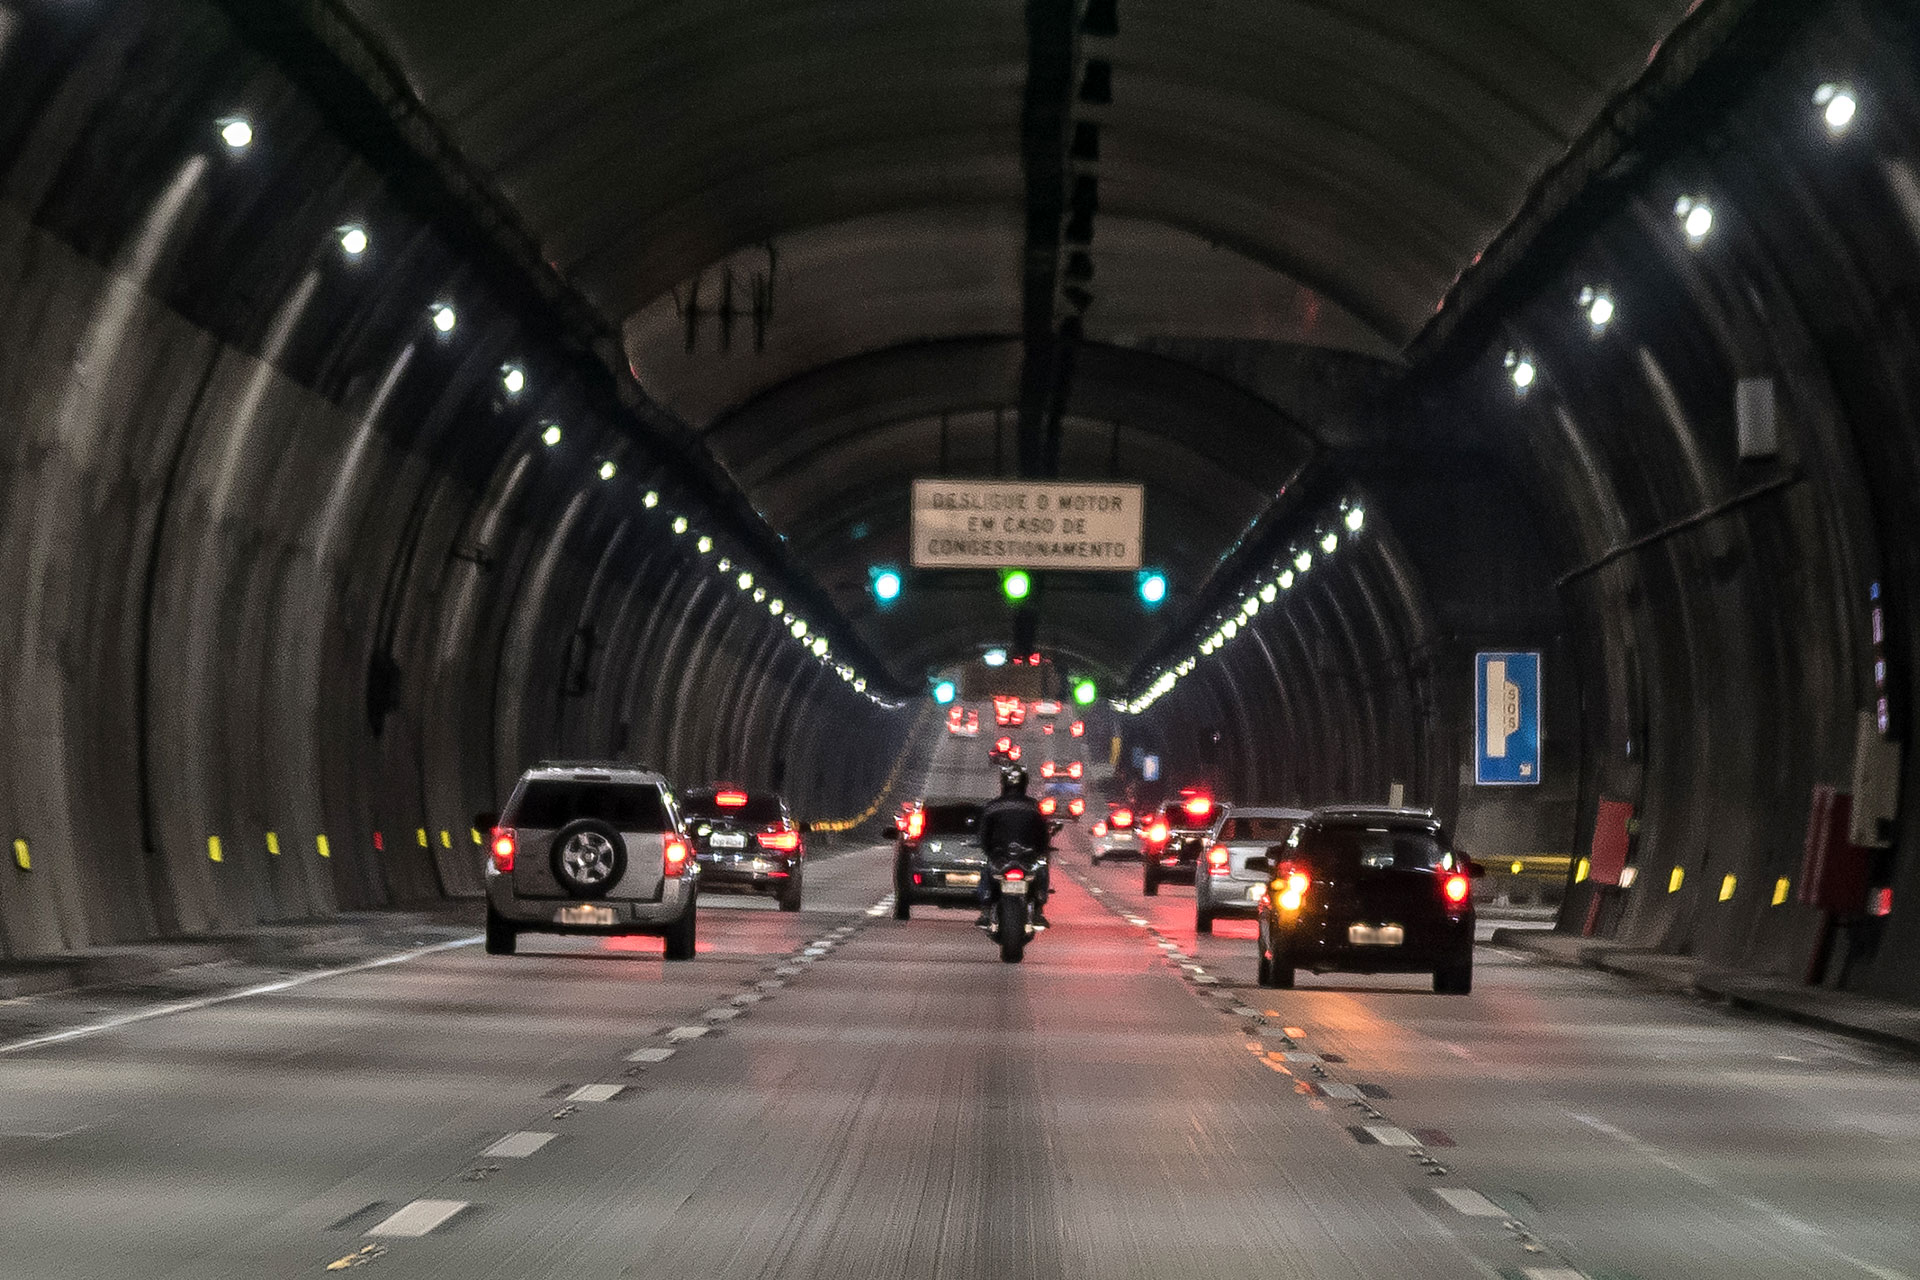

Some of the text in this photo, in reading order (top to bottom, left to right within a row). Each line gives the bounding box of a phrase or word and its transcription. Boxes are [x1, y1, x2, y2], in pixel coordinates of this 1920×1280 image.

[1037, 494, 1049, 510] O
[1059, 495, 1122, 511] MOTOR
[968, 517, 1086, 534] EM CASO DE
[928, 539, 1125, 558] CONGESTIONAMENTO
[1507, 689, 1516, 729] SOS
